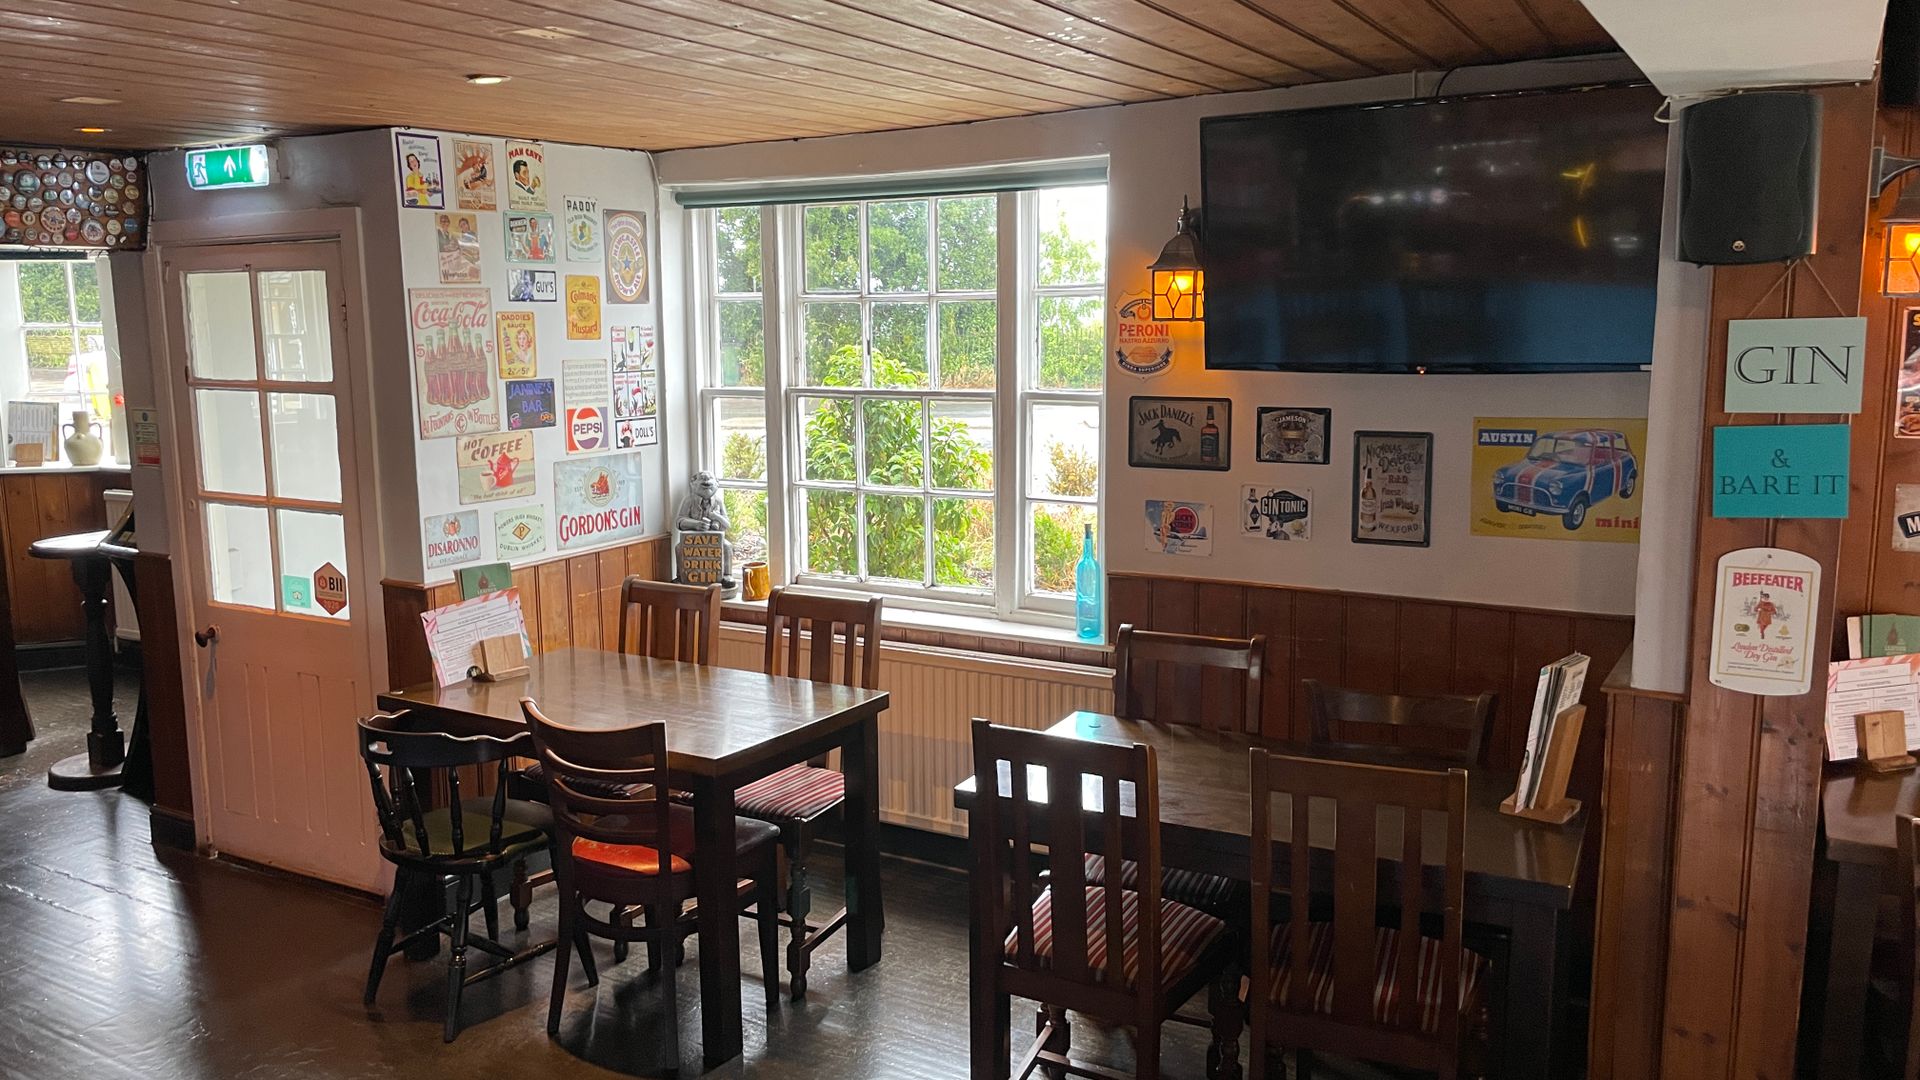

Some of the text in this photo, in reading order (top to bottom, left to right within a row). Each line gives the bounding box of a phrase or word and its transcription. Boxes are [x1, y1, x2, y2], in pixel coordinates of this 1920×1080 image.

[566, 199, 597, 213] PADDY
[612, 234, 641, 258] NEWCASTLE
[535, 281, 554, 293] GUY'S
[613, 273, 642, 296] BROWN ALE
[413, 301, 489, 330] Coca-Cola
[501, 313, 531, 321] DADDIES
[571, 321, 598, 335] Mustard
[1119, 323, 1169, 337] PERONI
[1733, 345, 1857, 385] GIN
[522, 399, 543, 413] BAR
[1138, 404, 1195, 428] JACK DANIEL'S
[1279, 415, 1306, 424] JAMESON
[573, 422, 603, 436] PEPSI
[634, 426, 655, 440] DOLL'S
[463, 438, 484, 451] HOT
[1480, 431, 1534, 444] AUSTIN
[471, 438, 523, 461] COFFEE
[1771, 448, 1791, 468] &
[1719, 474, 1845, 495] BARE IT
[559, 505, 641, 545] GORDON'S GIN
[1595, 516, 1640, 529] mini
[428, 535, 479, 558] DISARONNO
[684, 535, 719, 545] SAVE
[683, 547, 722, 558] WATER
[683, 560, 722, 569] DRINK
[1732, 572, 1803, 592] BEEFEATER
[1744, 650, 1778, 664] Dry Gin
